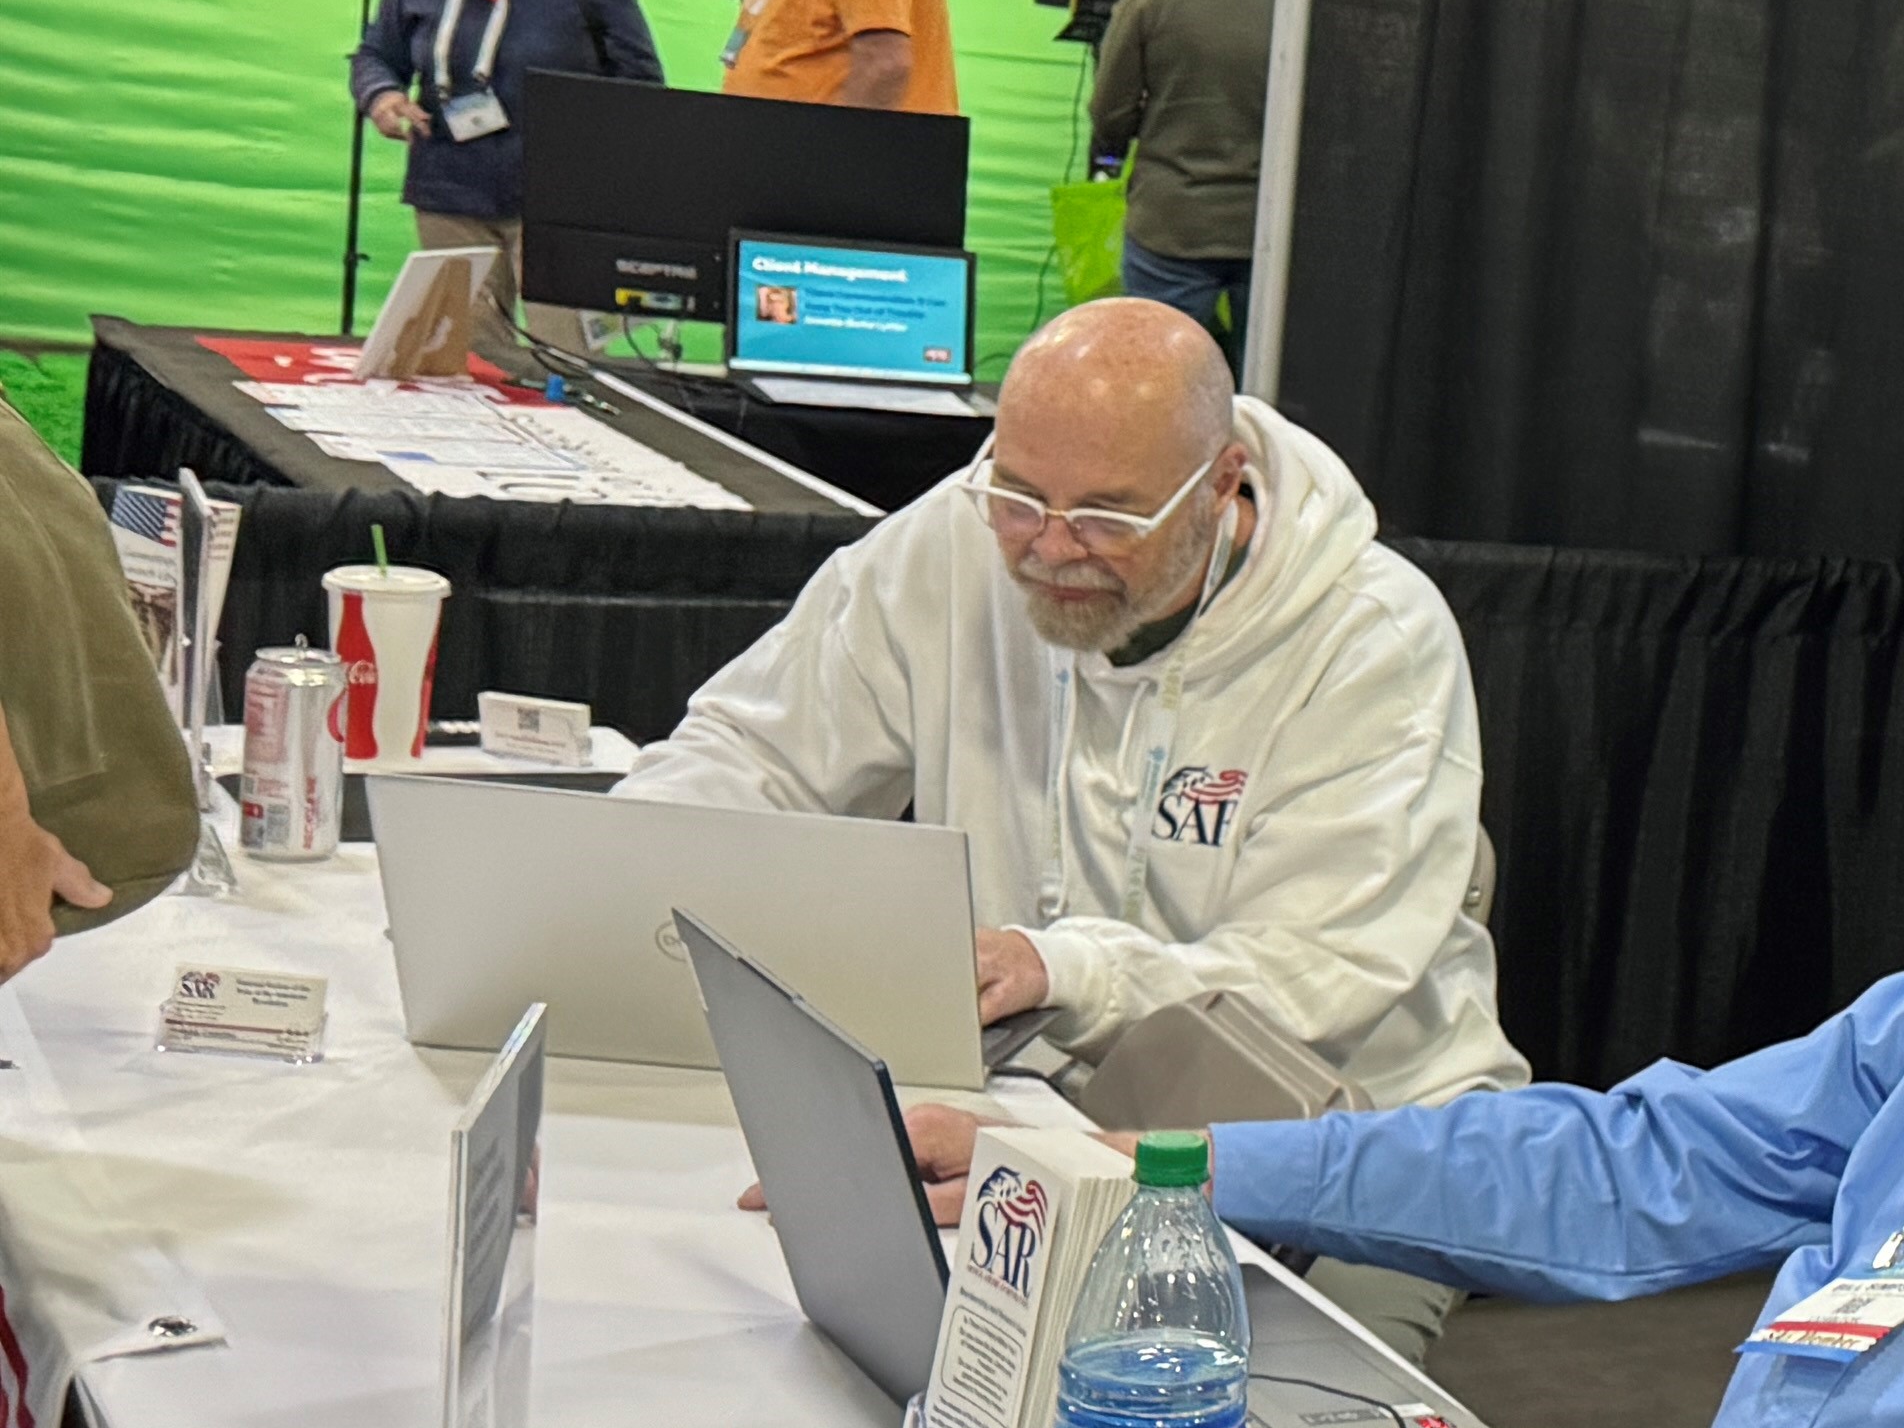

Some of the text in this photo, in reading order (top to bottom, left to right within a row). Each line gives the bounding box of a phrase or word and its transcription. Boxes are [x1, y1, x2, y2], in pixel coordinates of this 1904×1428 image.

[752, 256, 909, 283] Client Management
[971, 1201, 1037, 1299] SAR
